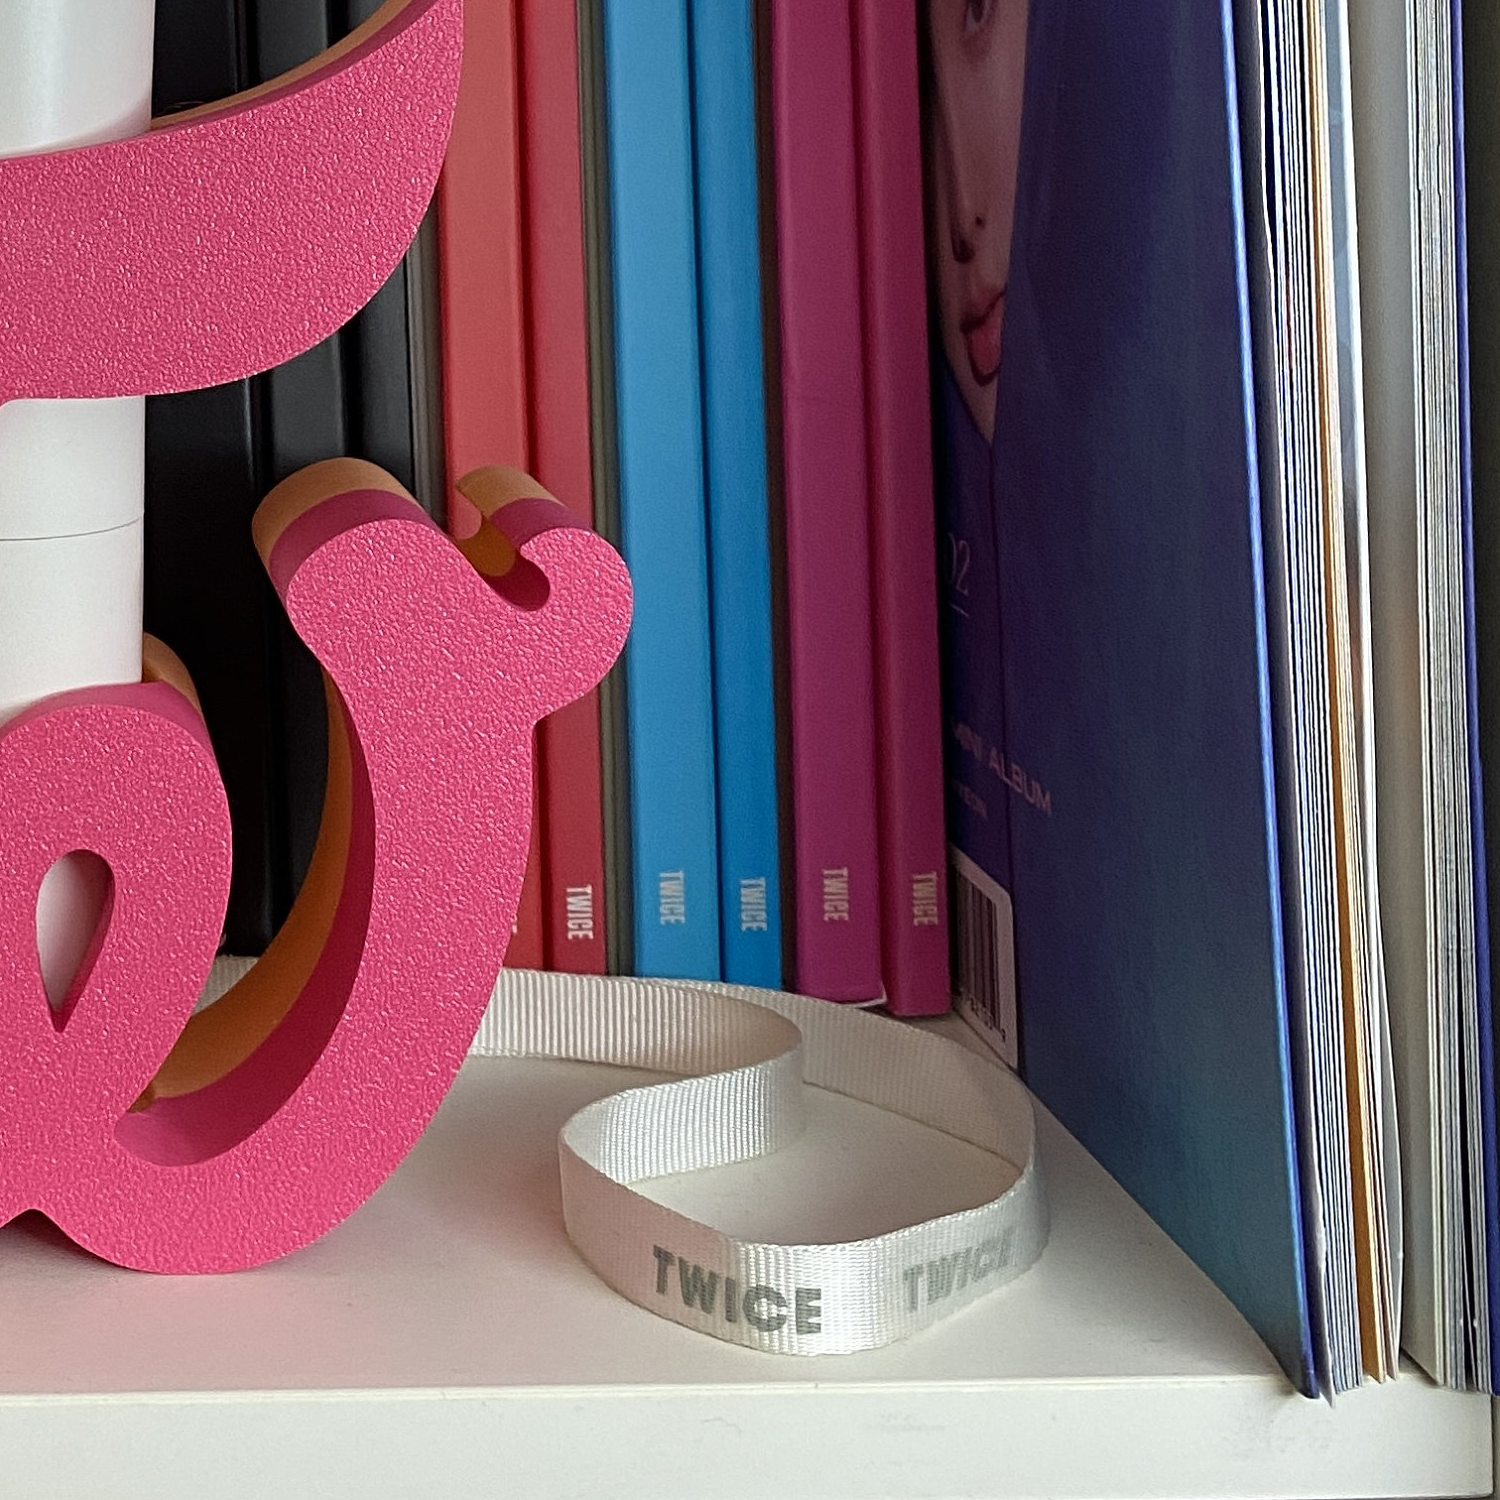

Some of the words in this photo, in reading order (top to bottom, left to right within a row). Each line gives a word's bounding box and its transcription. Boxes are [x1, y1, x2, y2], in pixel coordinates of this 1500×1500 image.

[989, 746, 1051, 818] ALBUM
[566, 883, 594, 940] TWICE
[659, 869, 687, 925] TWICE
[739, 877, 767, 931] TWICE
[822, 866, 849, 922] TWICE
[913, 870, 938, 926] TWICE
[652, 1245, 822, 1336] TWICE
